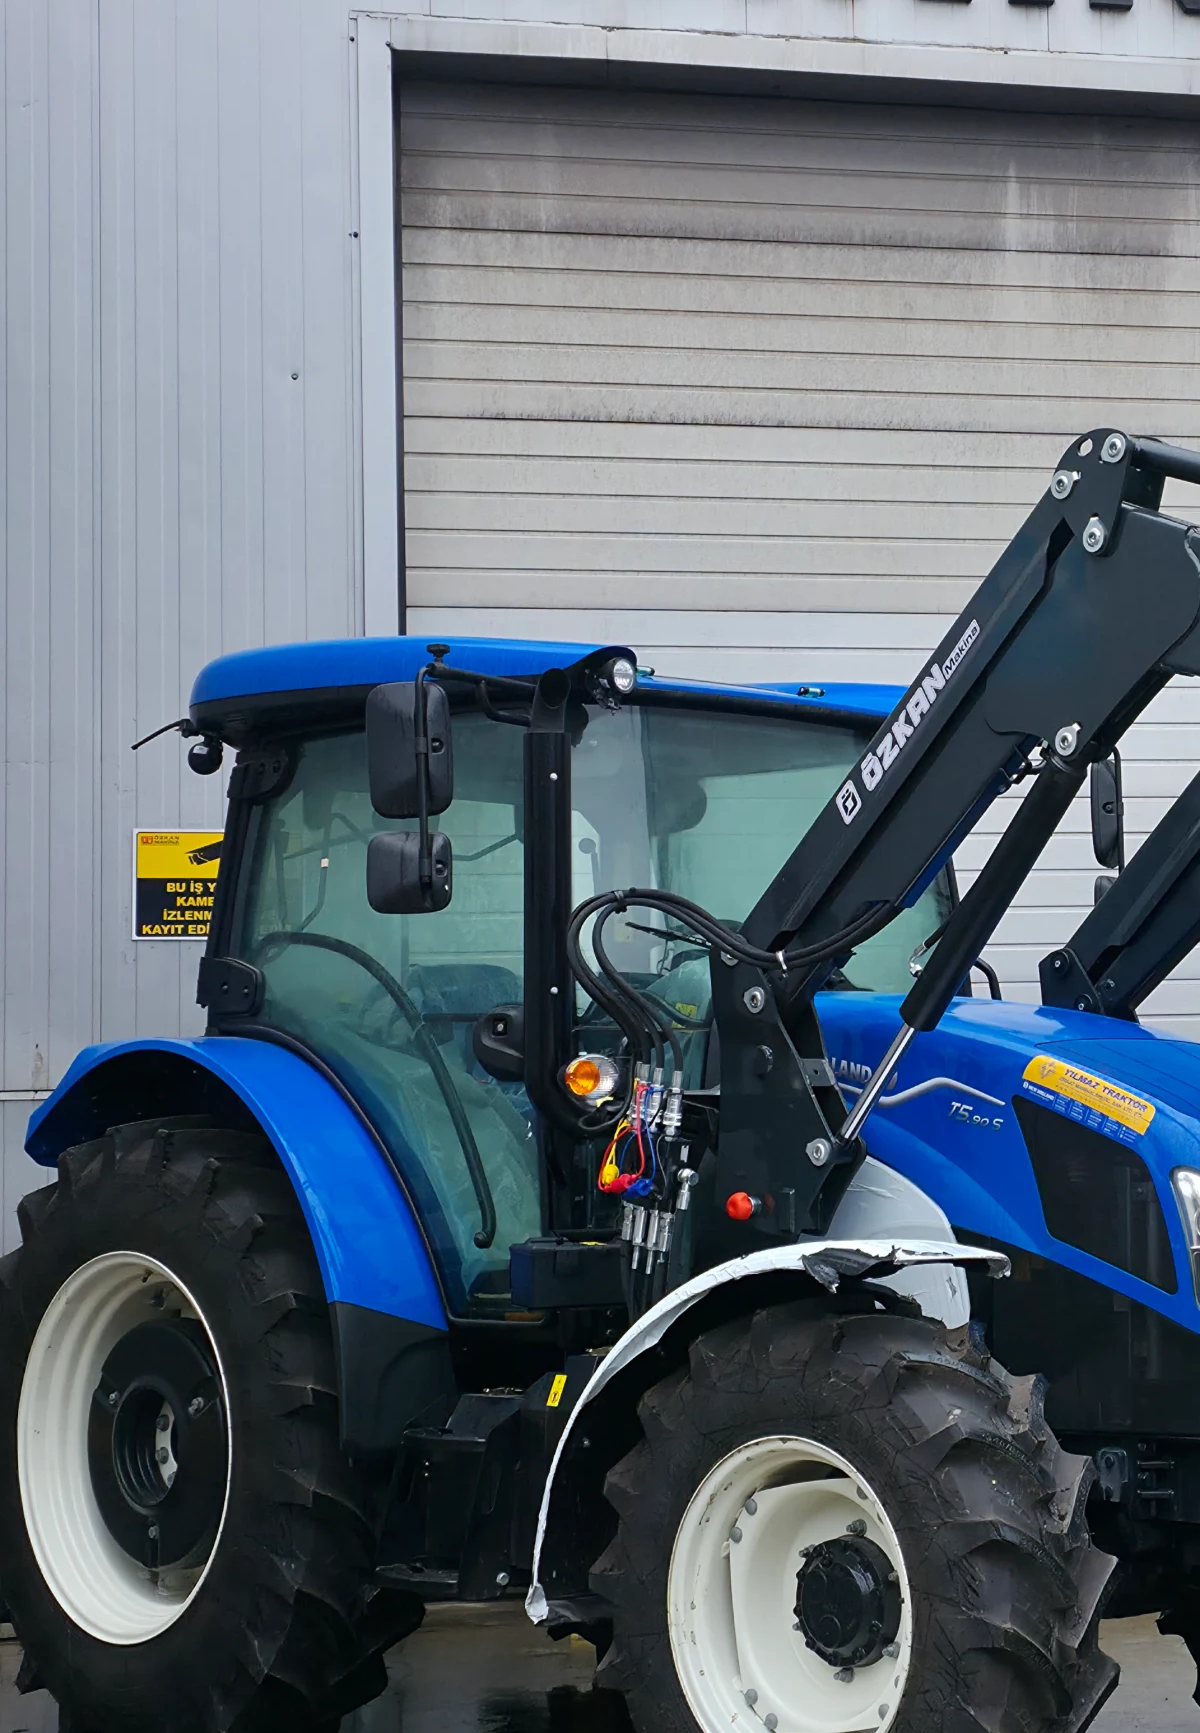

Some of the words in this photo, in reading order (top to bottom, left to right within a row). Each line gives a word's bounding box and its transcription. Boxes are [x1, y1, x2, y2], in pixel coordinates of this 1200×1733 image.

[860, 662, 946, 792] ÖZKAN
[944, 624, 979, 675] Makina
[166, 882, 186, 892] BU
[190, 881, 203, 894] İŞ
[142, 924, 184, 934] KAYIT
[1064, 1068, 1100, 1089] YILMAZ
[949, 1101, 989, 1127] T5.90
